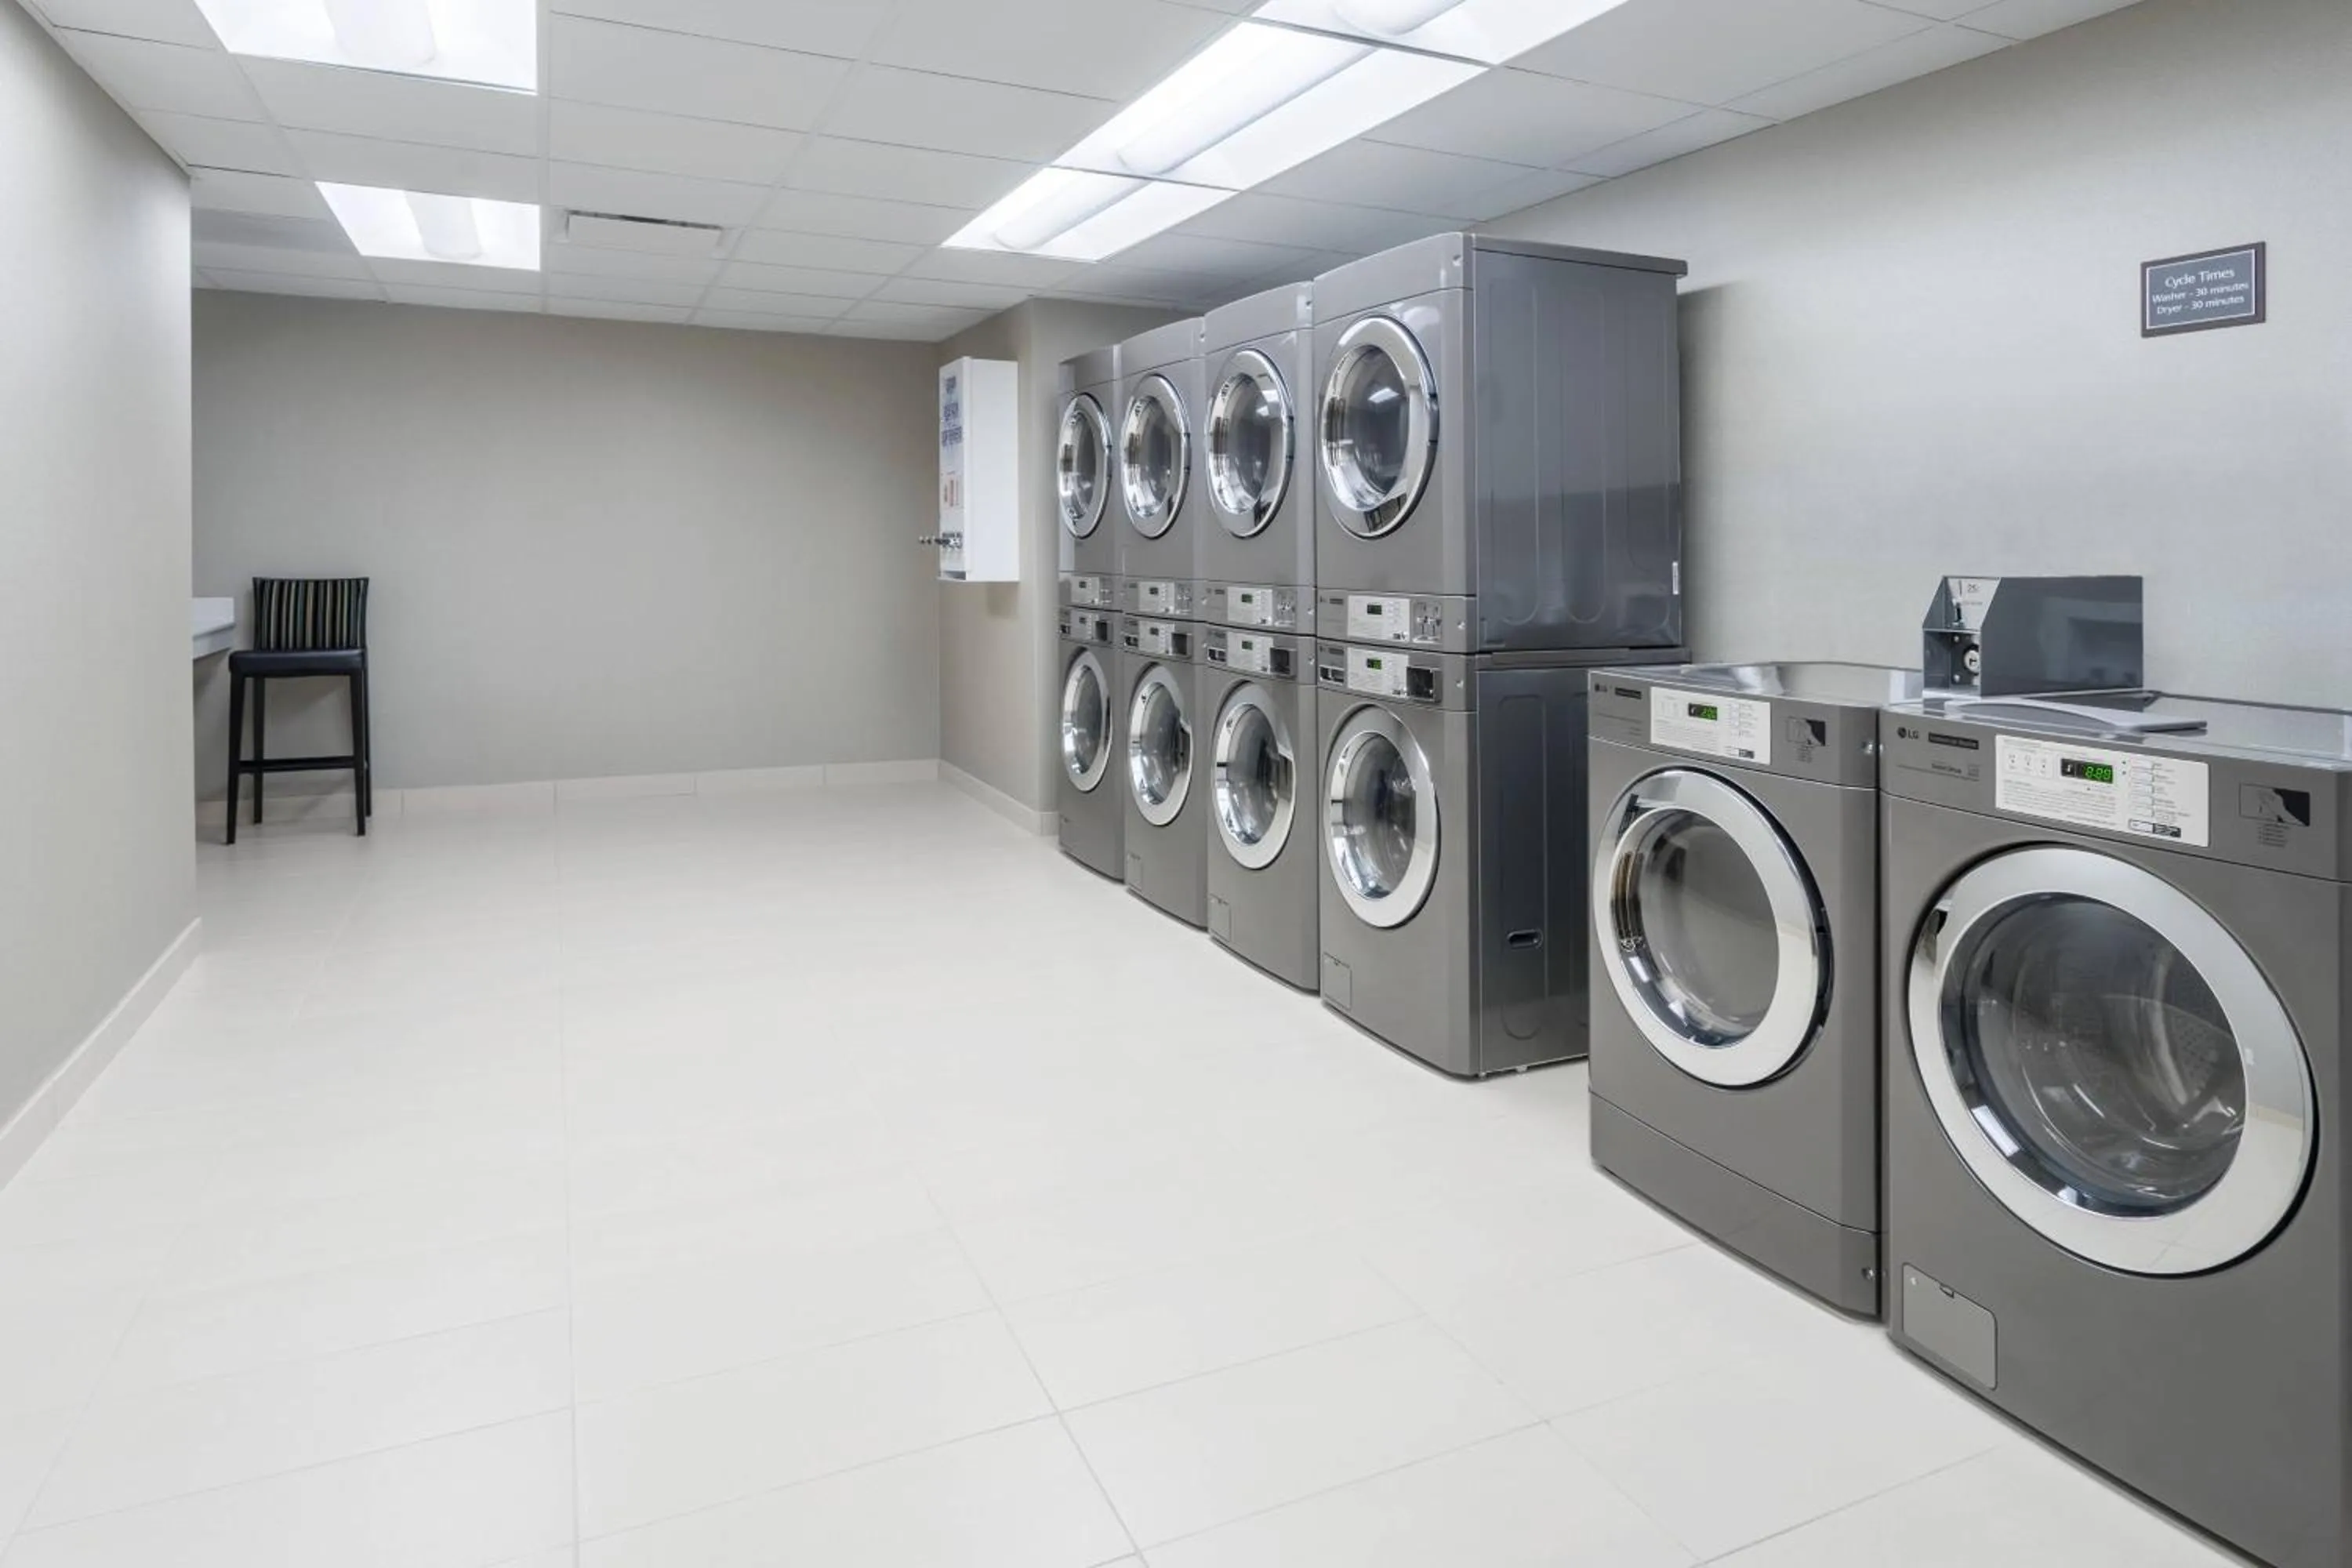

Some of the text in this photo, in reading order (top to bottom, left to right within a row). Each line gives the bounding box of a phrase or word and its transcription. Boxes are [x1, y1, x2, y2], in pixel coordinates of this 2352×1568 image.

[2165, 269, 2235, 289] Cycle Times
[2152, 292, 2187, 303] Washer
[2196, 287, 2209, 297] 30
[2210, 282, 2249, 295] minutes
[2157, 305, 2183, 315] Dryer
[2191, 300, 2204, 310] 30
[2205, 296, 2245, 307] minutes
